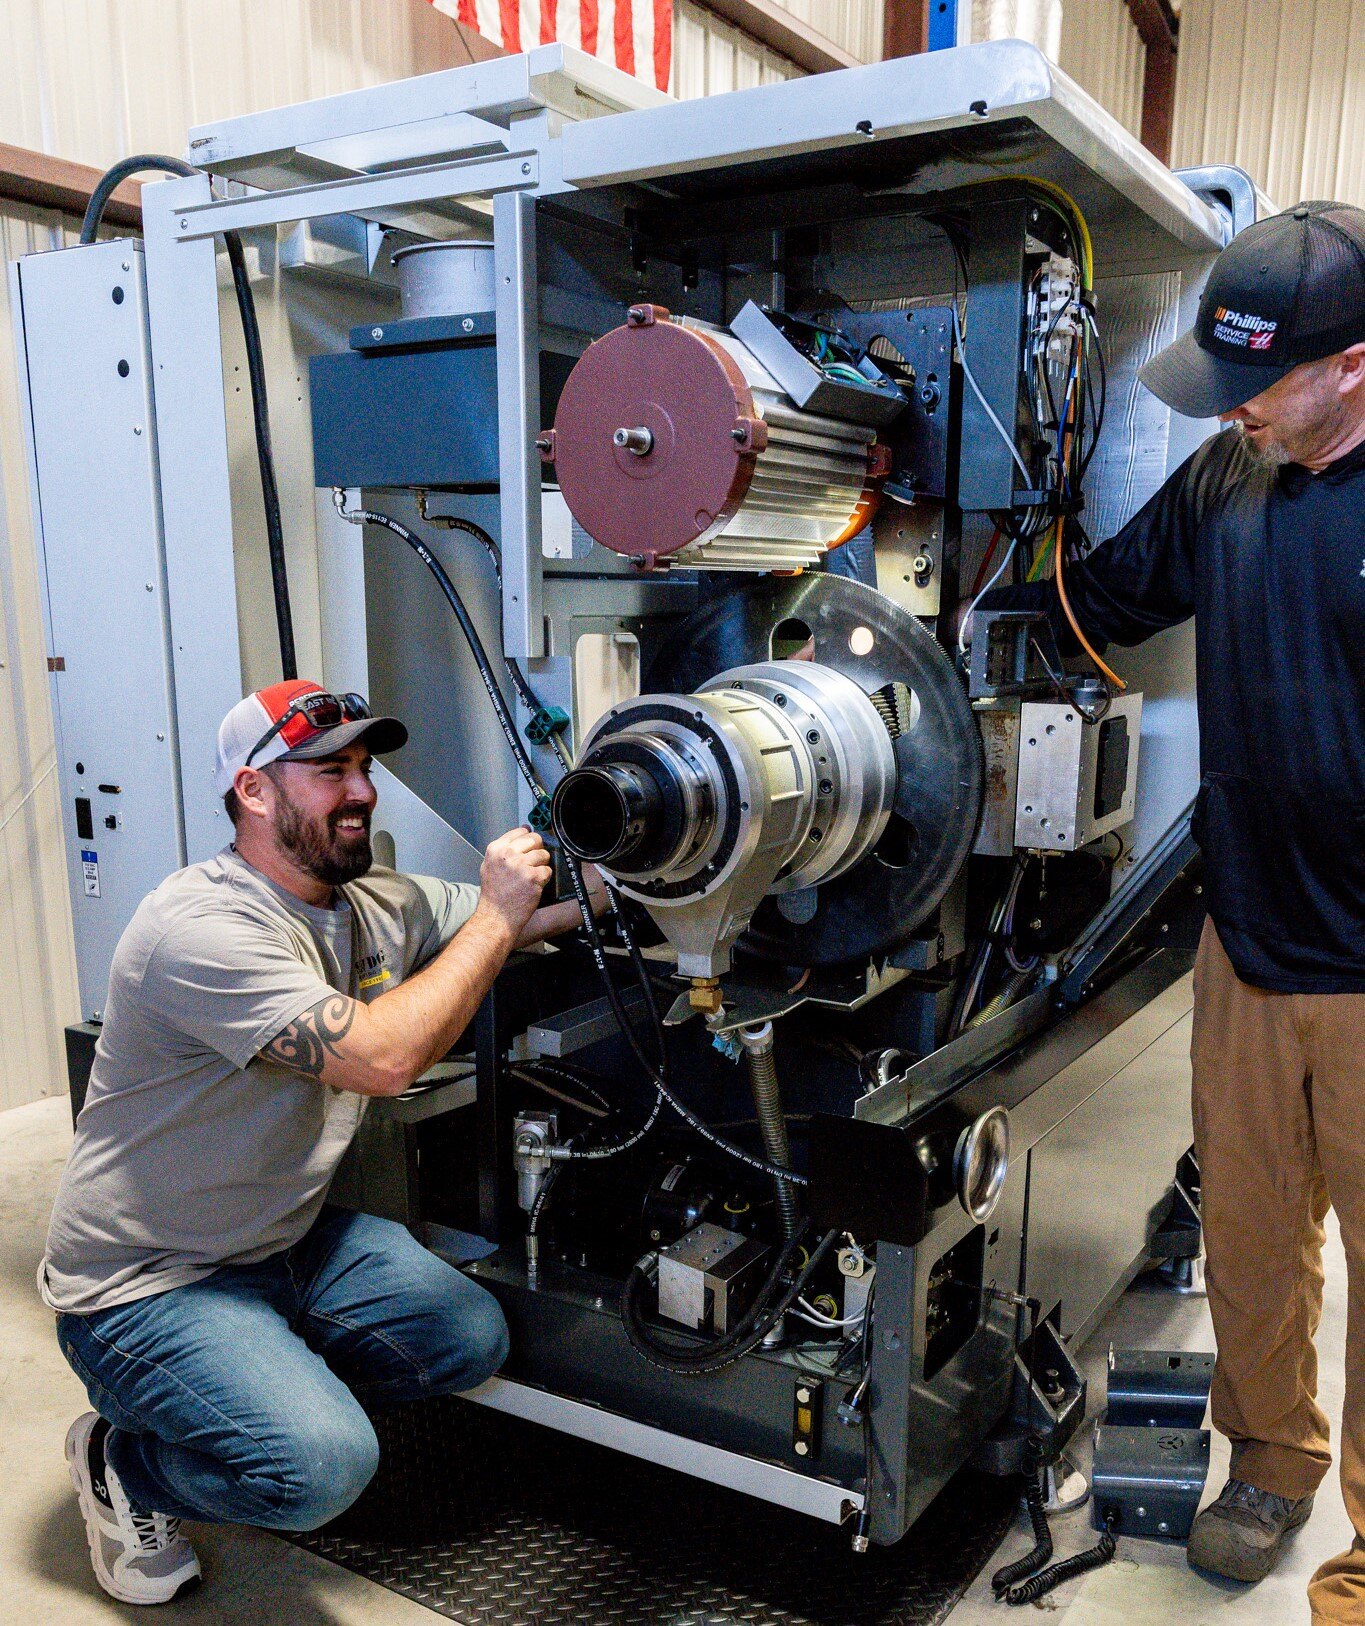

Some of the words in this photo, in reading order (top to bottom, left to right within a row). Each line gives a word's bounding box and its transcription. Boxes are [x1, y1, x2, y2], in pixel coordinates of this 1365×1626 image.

[1223, 310, 1277, 332] Phillips
[1213, 329, 1247, 347] TRAINING
[1215, 323, 1250, 340] SERVICE
[388, 521, 409, 539] WINNER
[490, 692, 501, 711] MSHA
[504, 727, 516, 746] EN857
[528, 777, 536, 787] bar
[533, 787, 541, 798] 180
[570, 870, 584, 901] EC115-06
[605, 885, 618, 914] WINNER
[580, 904, 593, 933] WINNER
[671, 1100, 687, 1117] MSHA
[686, 1116, 697, 1127] 1SC
[530, 1216, 538, 1233] MSHA
